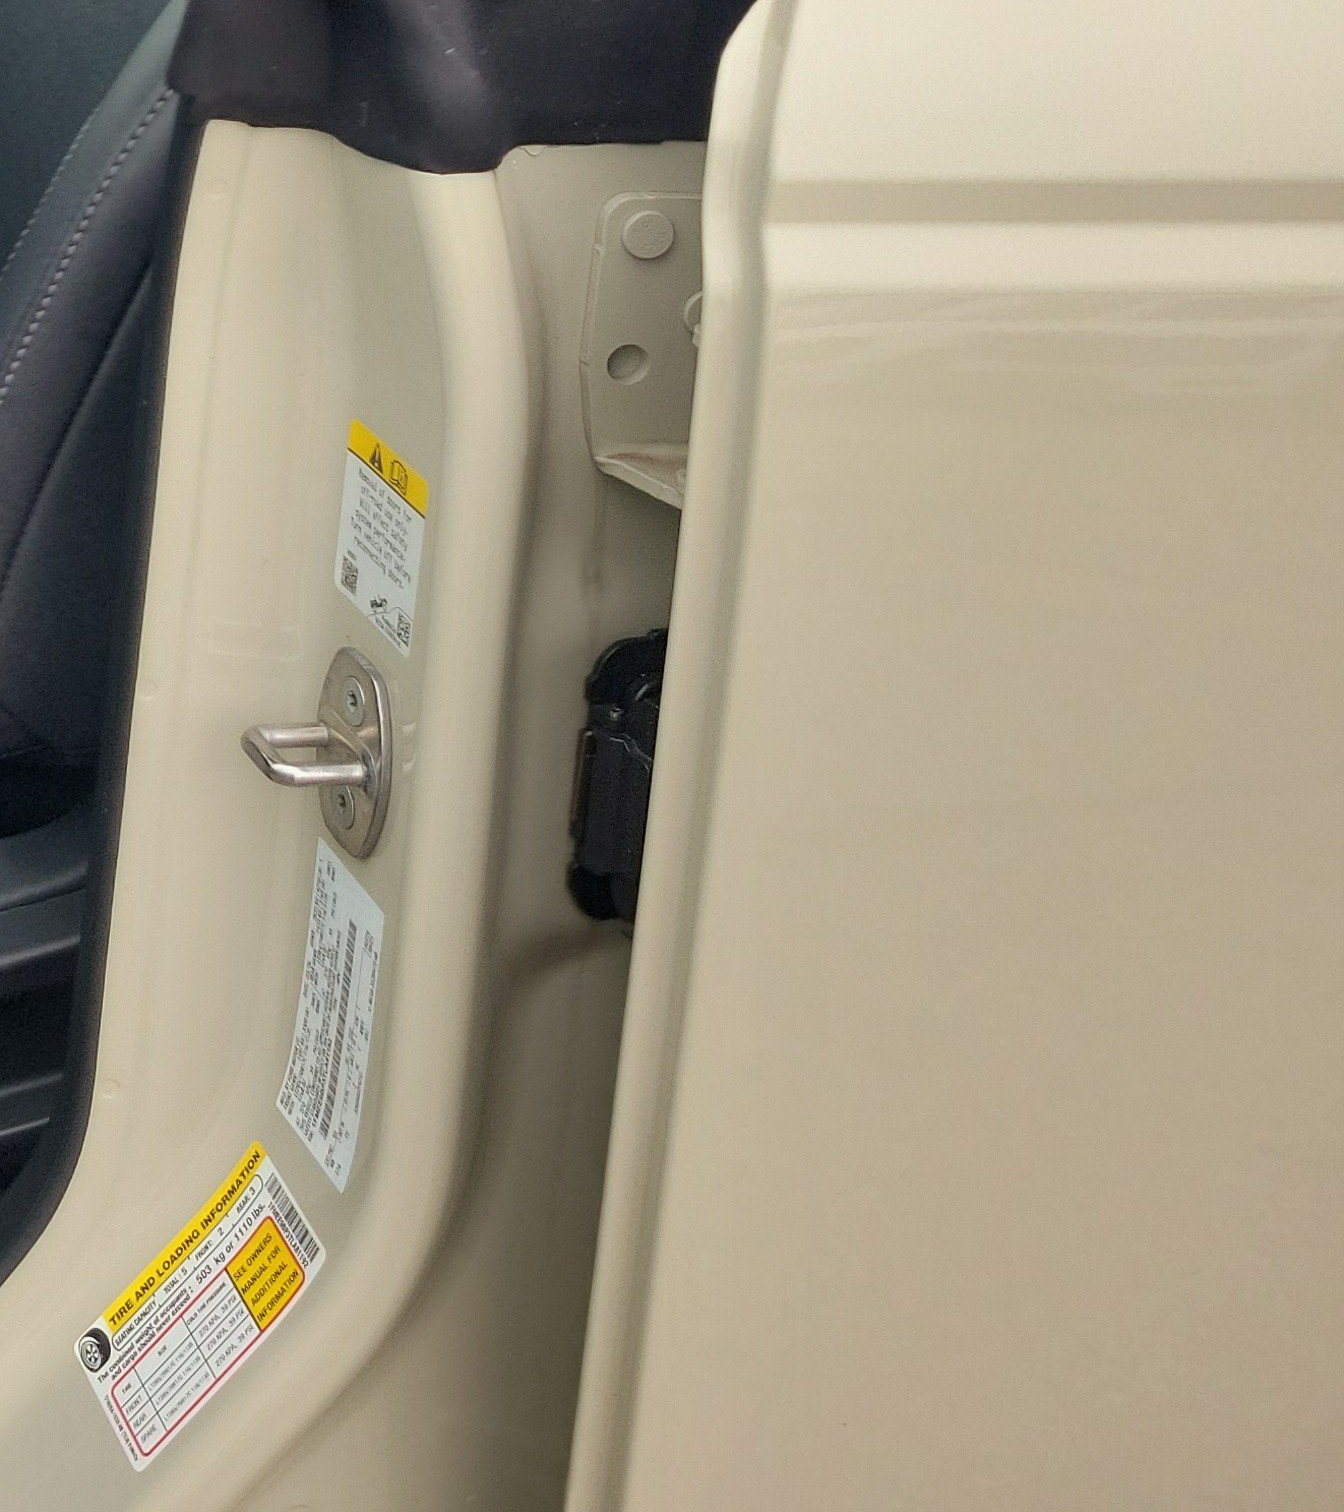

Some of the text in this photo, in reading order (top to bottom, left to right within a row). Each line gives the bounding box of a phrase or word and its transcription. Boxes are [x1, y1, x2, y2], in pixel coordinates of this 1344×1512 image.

[248, 1185, 256, 1196] 3
[108, 1149, 261, 1329] TIRE AND LOADING INFORMATION
[194, 1198, 266, 1285] 503 kg or 1110 lbs.
[216, 1225, 225, 1236] 2
[180, 1265, 188, 1276] 5
[232, 1231, 273, 1282] SEE OWNERS
[239, 1243, 282, 1295] MANUAL FOR
[248, 1258, 288, 1307] ADDITIONAL
[255, 1267, 300, 1323] INFORMATION
[97, 1368, 109, 1384] The
[107, 1341, 135, 1373] combined
[133, 1320, 155, 1346] weight
[158, 1285, 188, 1319] occupants
[110, 1366, 122, 1381] and
[121, 1349, 138, 1371] cargo
[136, 1329, 156, 1353] should
[155, 1314, 171, 1333] never
[114, 1299, 157, 1347] SEATING CAPACITY
[124, 1393, 143, 1416] FRONT
